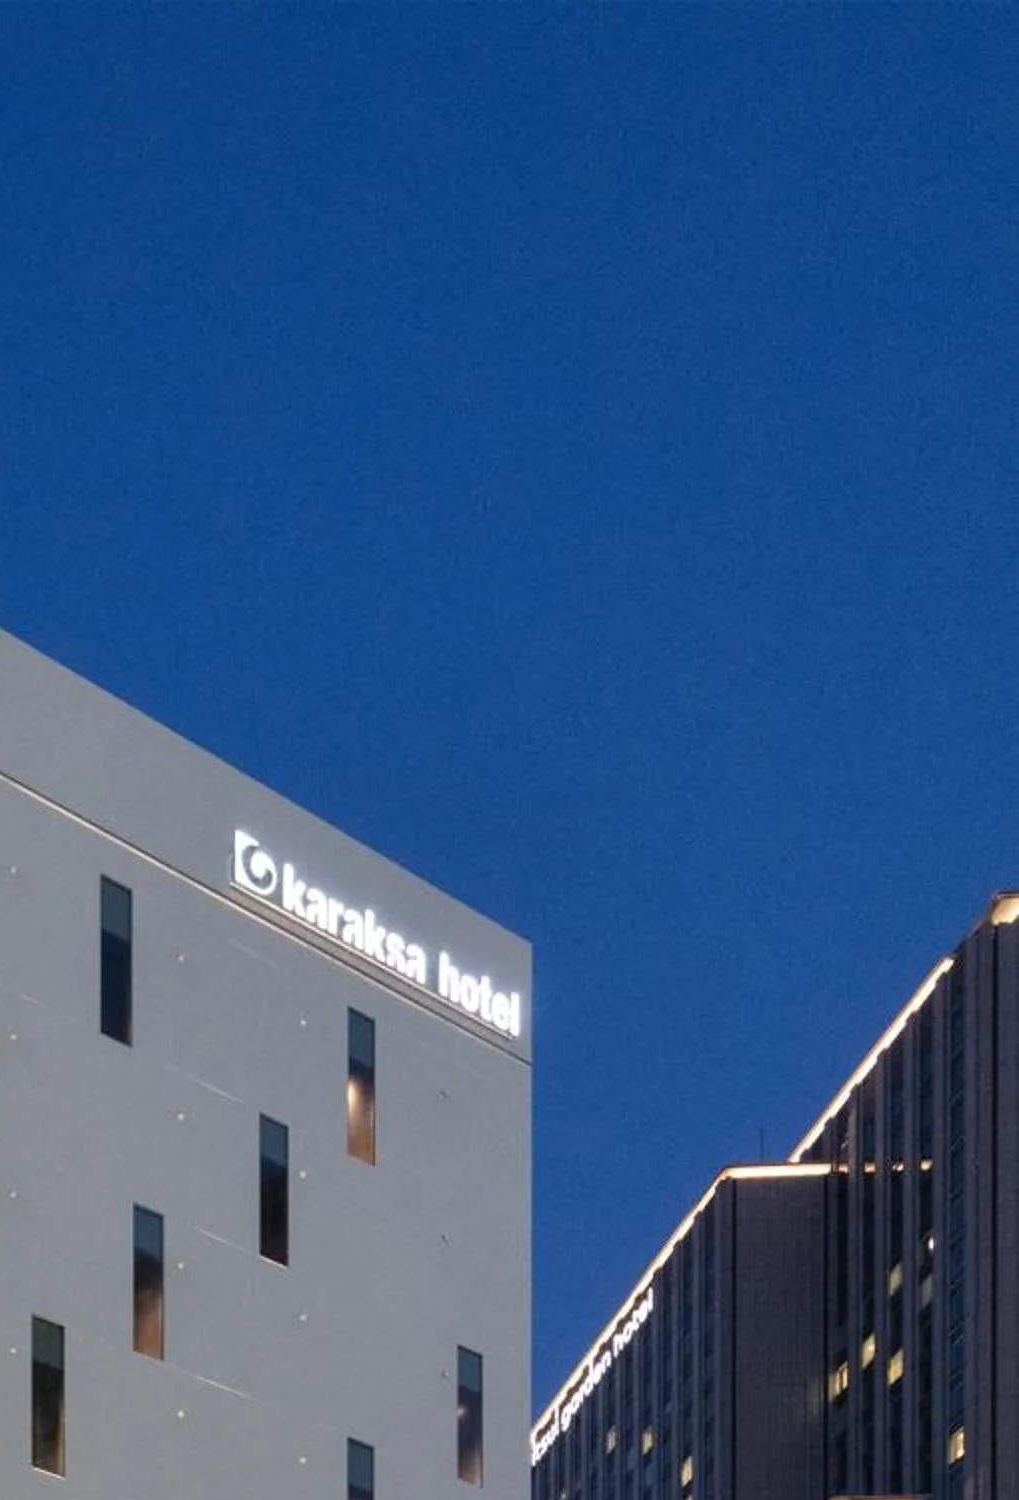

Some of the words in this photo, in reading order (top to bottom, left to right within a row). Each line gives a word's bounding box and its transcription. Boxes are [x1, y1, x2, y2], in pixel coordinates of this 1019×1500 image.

[282, 863, 427, 984] karaksa
[438, 952, 521, 1037] hotel
[561, 1350, 612, 1432] garden
[613, 1286, 654, 1358] hotel
